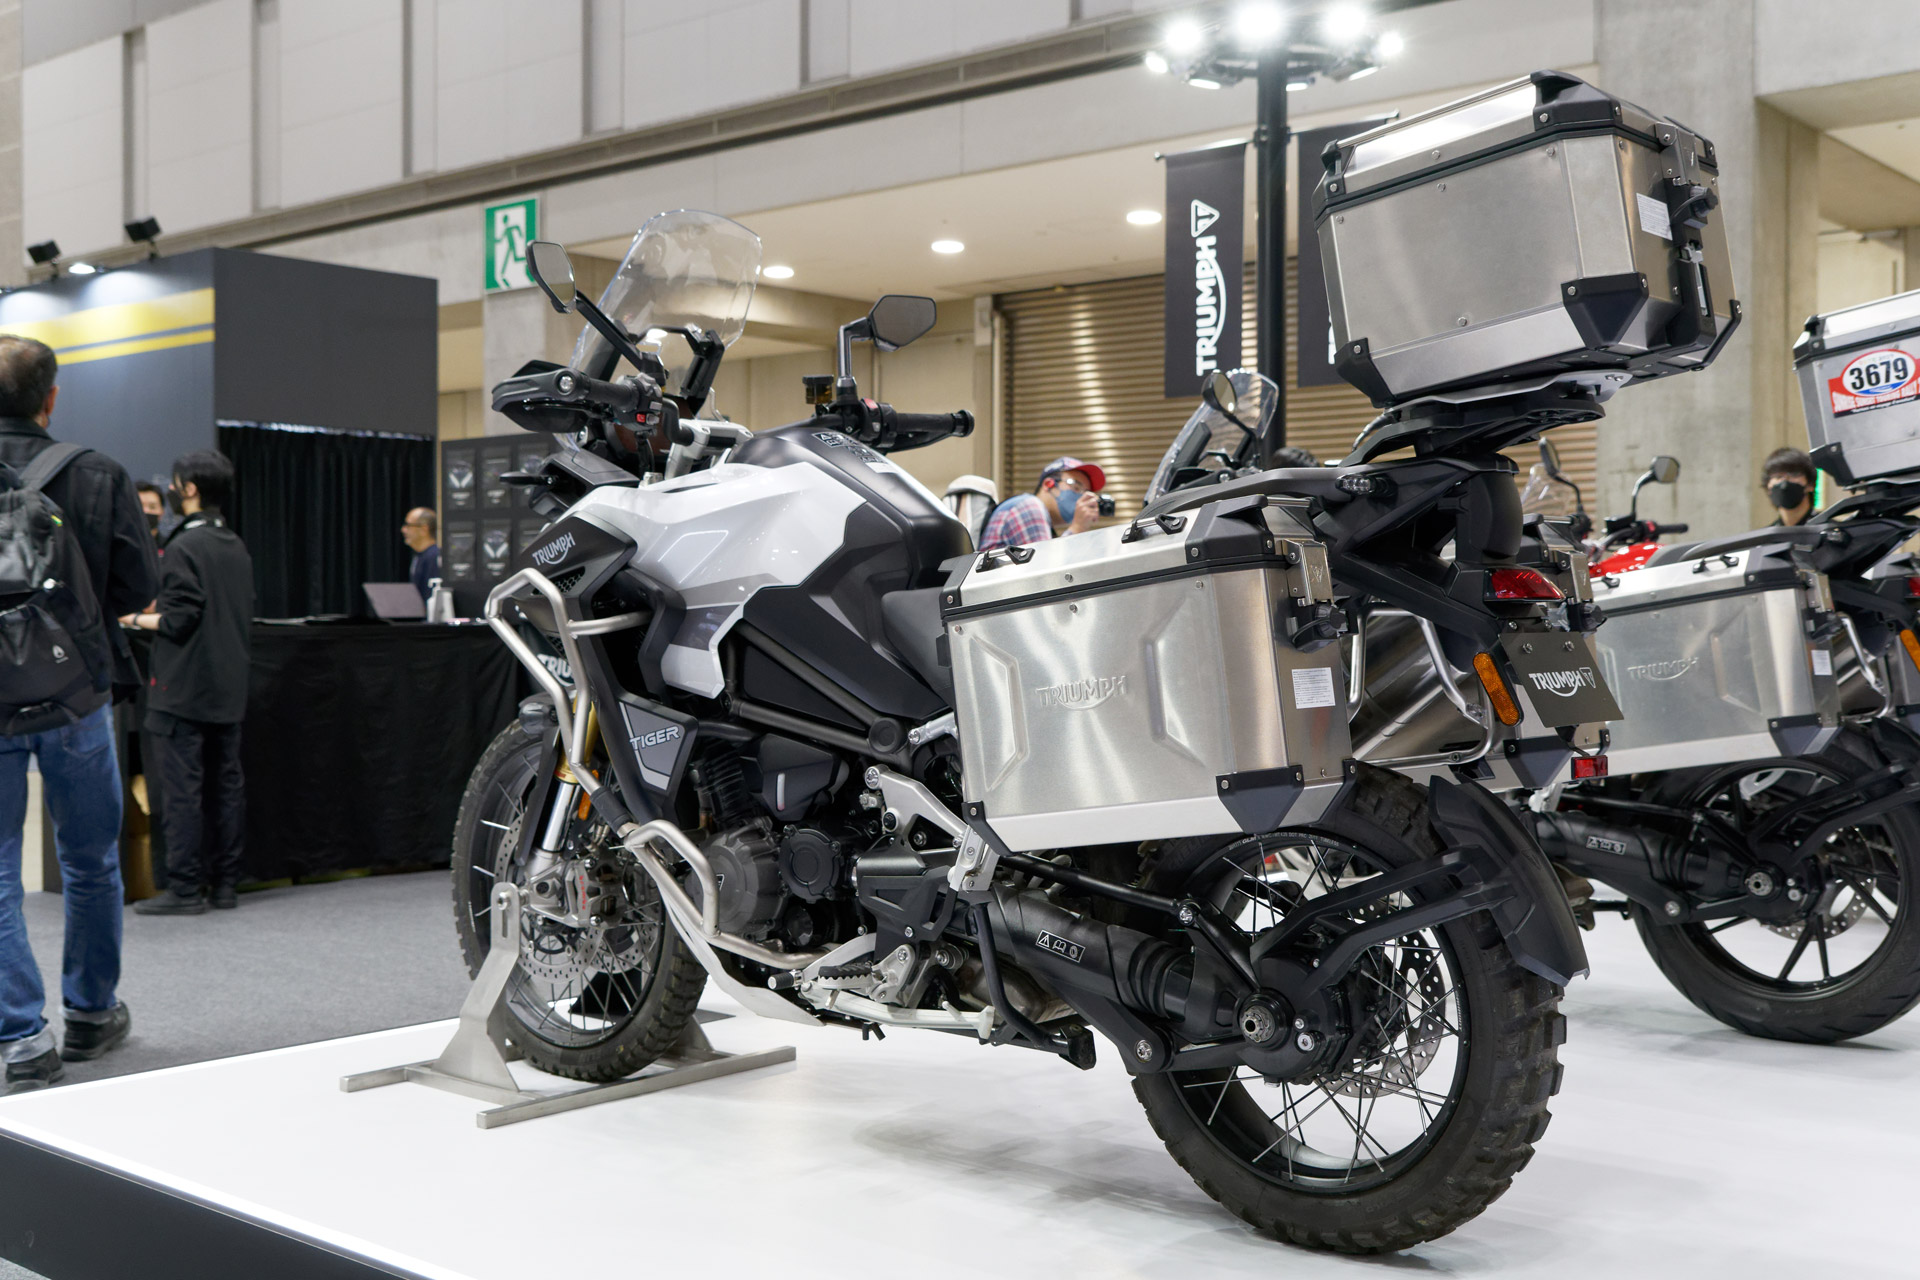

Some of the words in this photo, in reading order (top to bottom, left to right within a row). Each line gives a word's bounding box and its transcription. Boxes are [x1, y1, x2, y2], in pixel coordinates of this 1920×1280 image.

[1196, 236, 1226, 376] TRIUMPH
[1849, 357, 1909, 390] 3679
[532, 532, 576, 566] TRIUMPH
[536, 653, 574, 687] TRIU
[1528, 670, 1586, 697] TRIUMPH
[1627, 657, 1700, 681] TRIUMPH
[1036, 676, 1127, 709] TRIUMPH
[629, 725, 681, 751] TIGER
